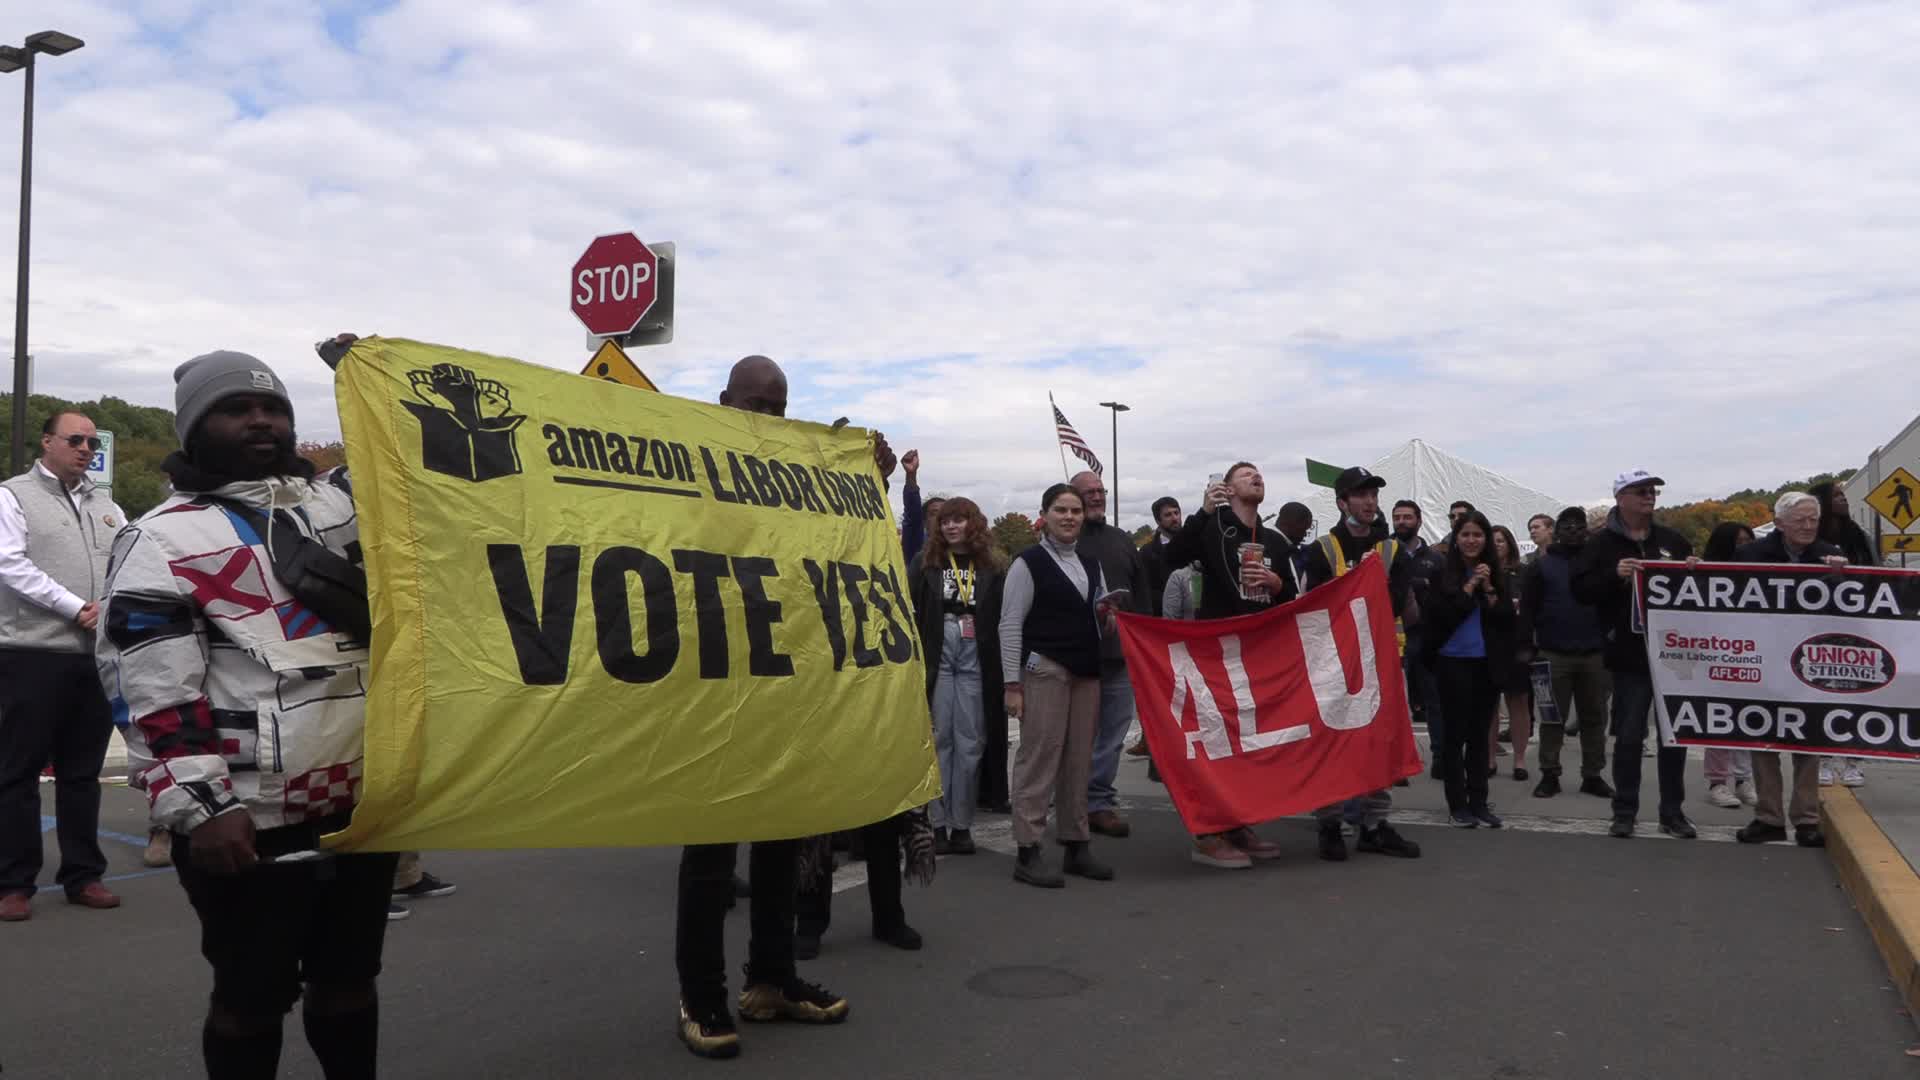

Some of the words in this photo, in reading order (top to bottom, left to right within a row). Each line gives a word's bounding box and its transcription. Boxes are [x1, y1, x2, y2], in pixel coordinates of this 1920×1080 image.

[576, 262, 651, 305] STOP
[542, 423, 696, 482] amazon
[699, 445, 827, 515] LABOR
[812, 466, 886, 520] UNION
[487, 544, 795, 685] VOTE
[803, 557, 920, 672] YES!
[1647, 575, 1901, 616] SARATOGA
[1659, 650, 1684, 660] Area
[1687, 652, 1718, 662] Labor
[1721, 654, 1762, 665] Council
[1665, 632, 1756, 655] Saratoga
[1807, 646, 1876, 666] UNION
[1168, 597, 1381, 760] ALU
[1711, 666, 1760, 681] AFL-CIO
[1808, 665, 1877, 680] STRONG!
[1671, 701, 1807, 740] ABOR
